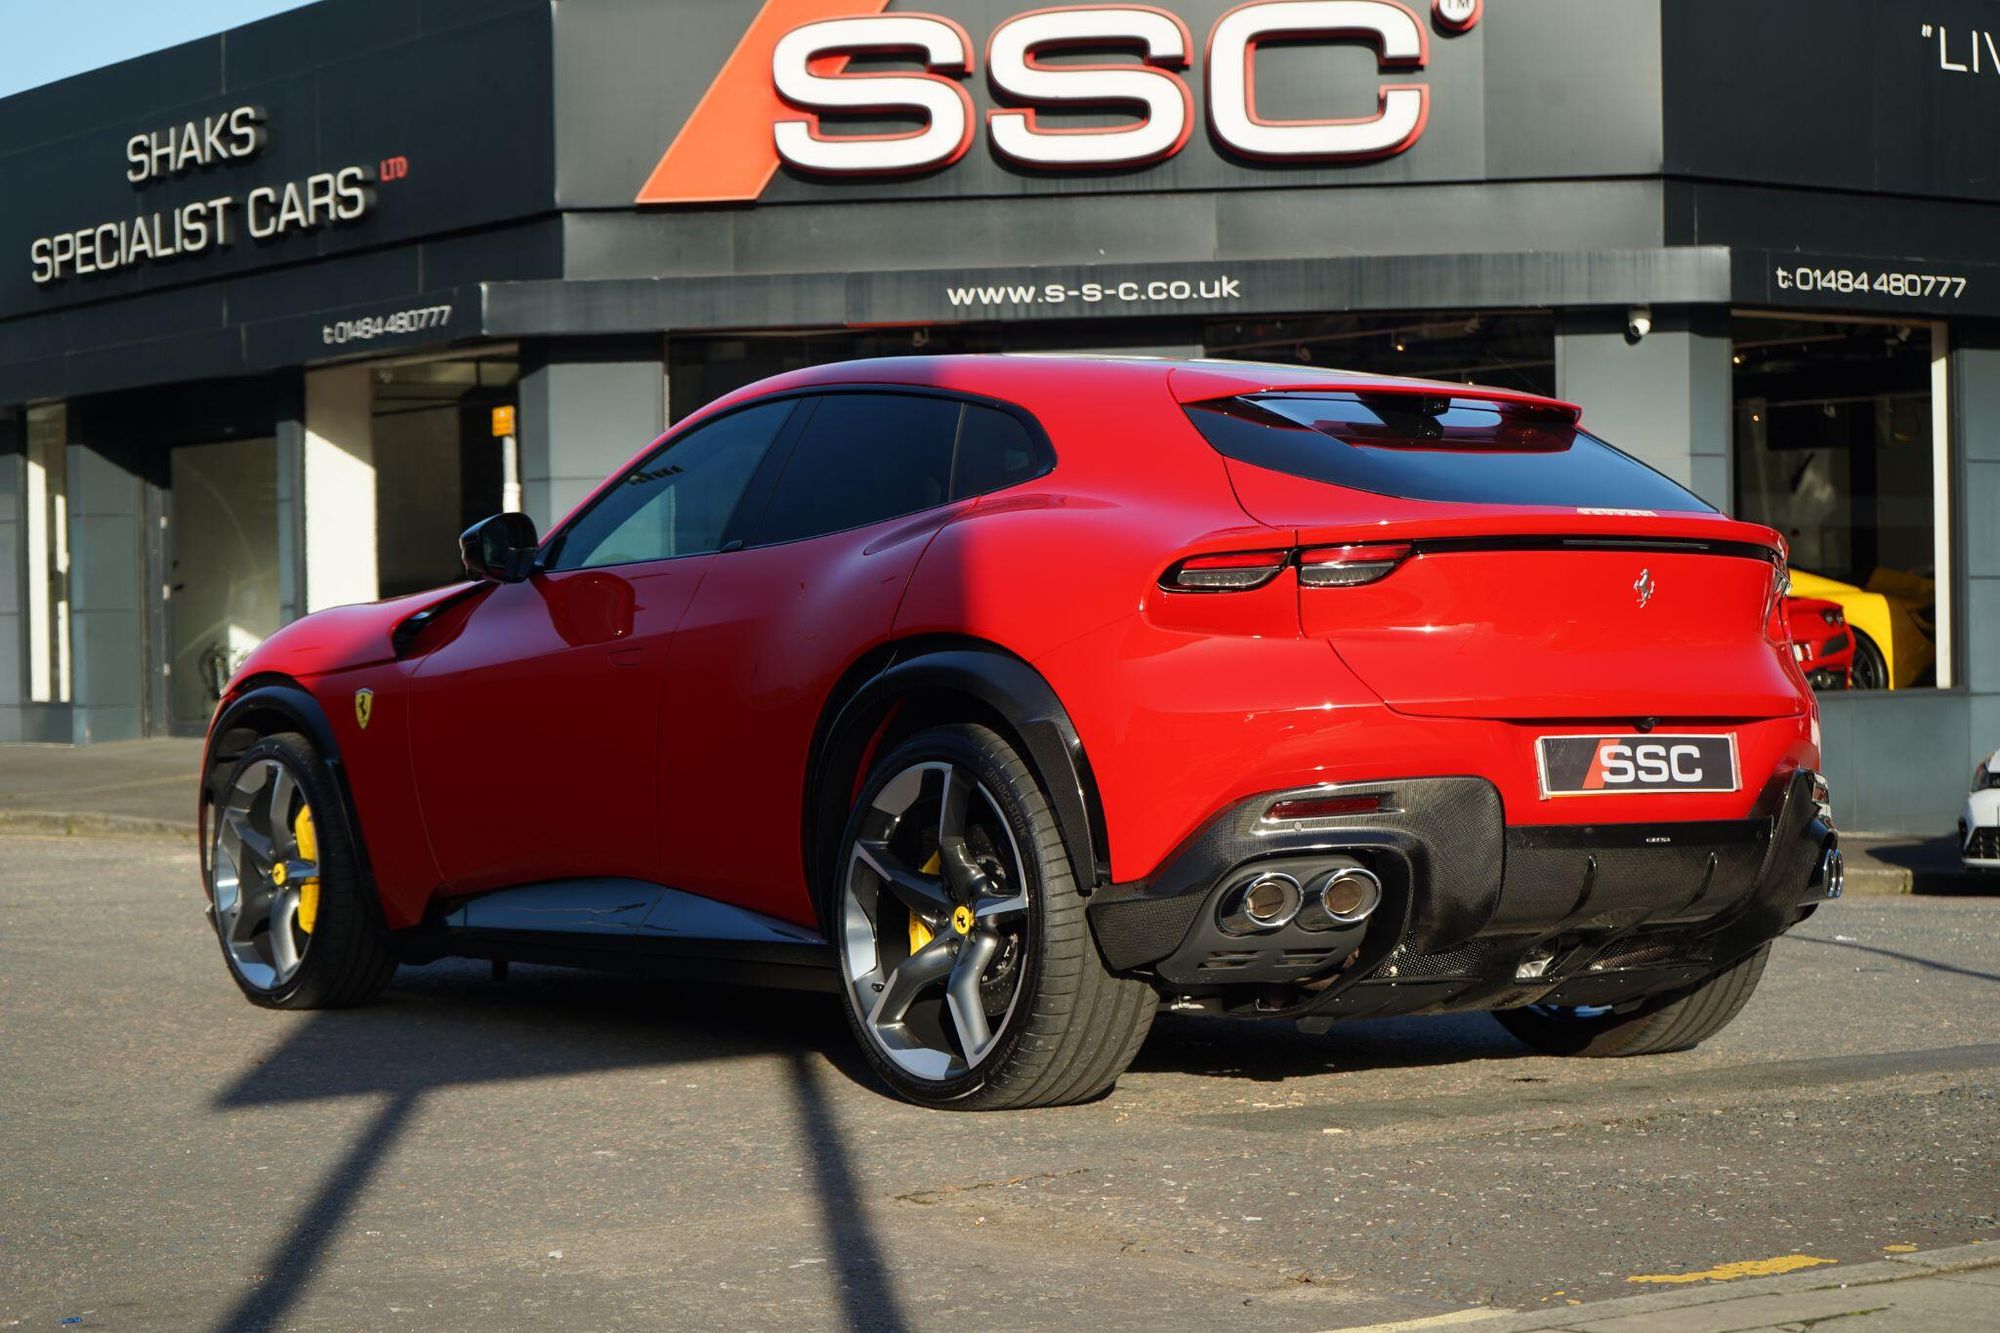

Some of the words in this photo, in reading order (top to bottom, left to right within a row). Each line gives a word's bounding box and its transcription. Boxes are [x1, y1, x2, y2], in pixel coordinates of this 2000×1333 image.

[773, 0, 1427, 173] SSC
[126, 106, 256, 183] SHAKS
[30, 196, 232, 283] SPECIALIST
[247, 166, 367, 240] CARS
[380, 156, 408, 182] LTD
[946, 275, 1240, 306] www.s-s-c.co.uk
[1873, 273, 1967, 299] 480777
[1599, 744, 1703, 783] SSC
